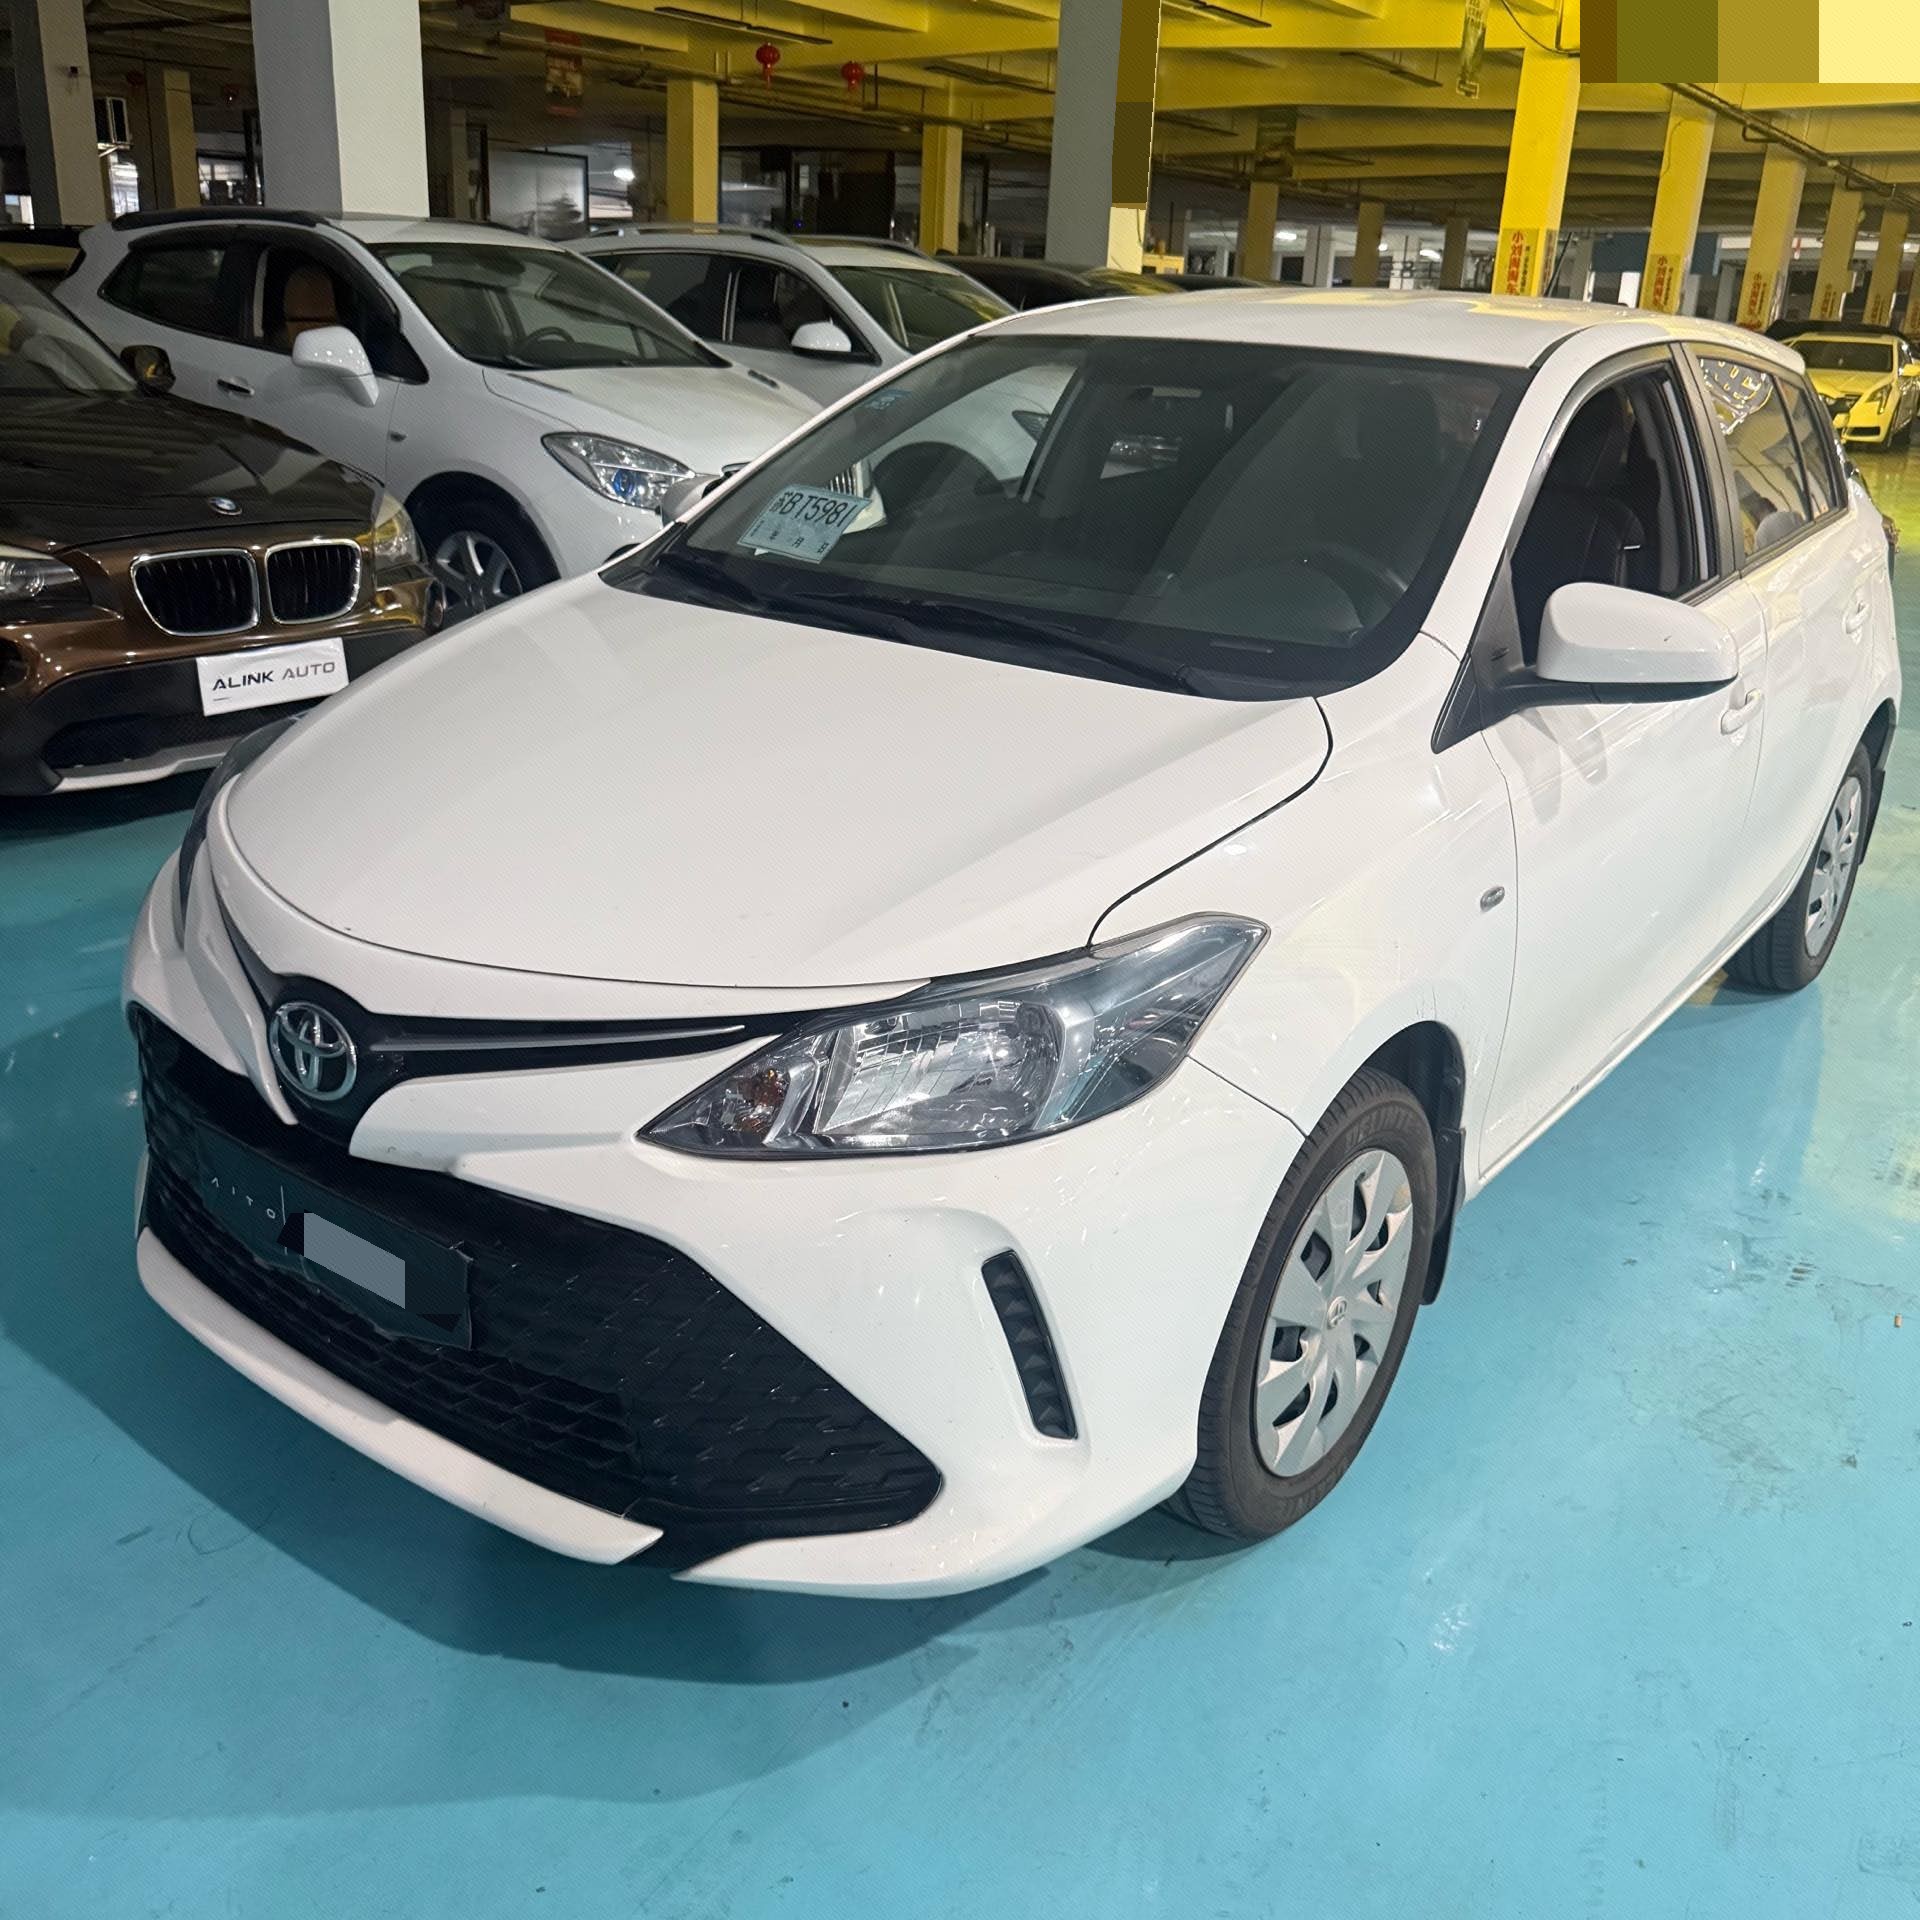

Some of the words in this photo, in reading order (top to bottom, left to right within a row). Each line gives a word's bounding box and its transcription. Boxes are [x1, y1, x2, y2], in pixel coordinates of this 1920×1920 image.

[212, 671, 275, 691] ALINK
[282, 662, 336, 681] AUTO
[211, 1177, 276, 1219] AITO
